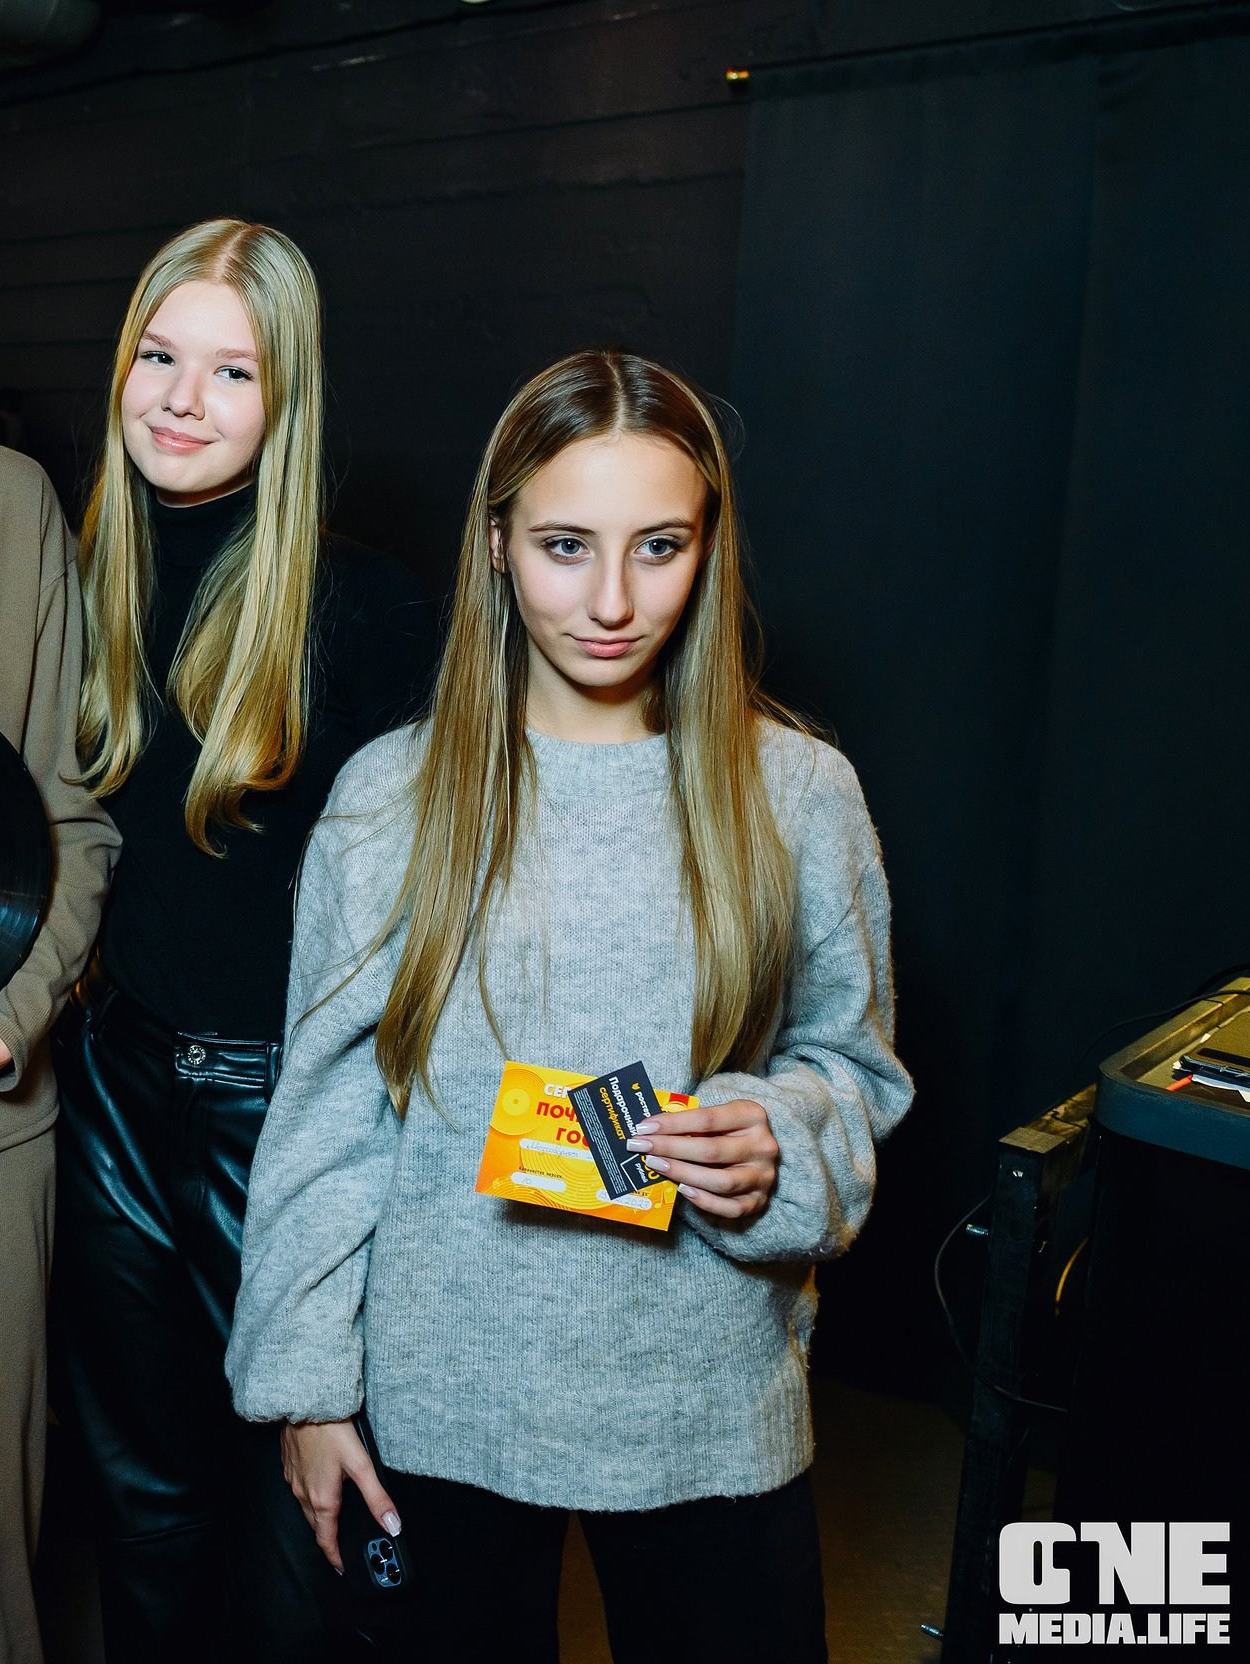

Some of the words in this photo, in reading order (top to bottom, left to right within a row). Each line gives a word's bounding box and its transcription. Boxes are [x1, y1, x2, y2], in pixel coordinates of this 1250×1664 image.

[536, 1101, 579, 1123] ПОЧ
[599, 1086, 627, 1141] сертификат
[608, 1076, 638, 1137] Подарочный
